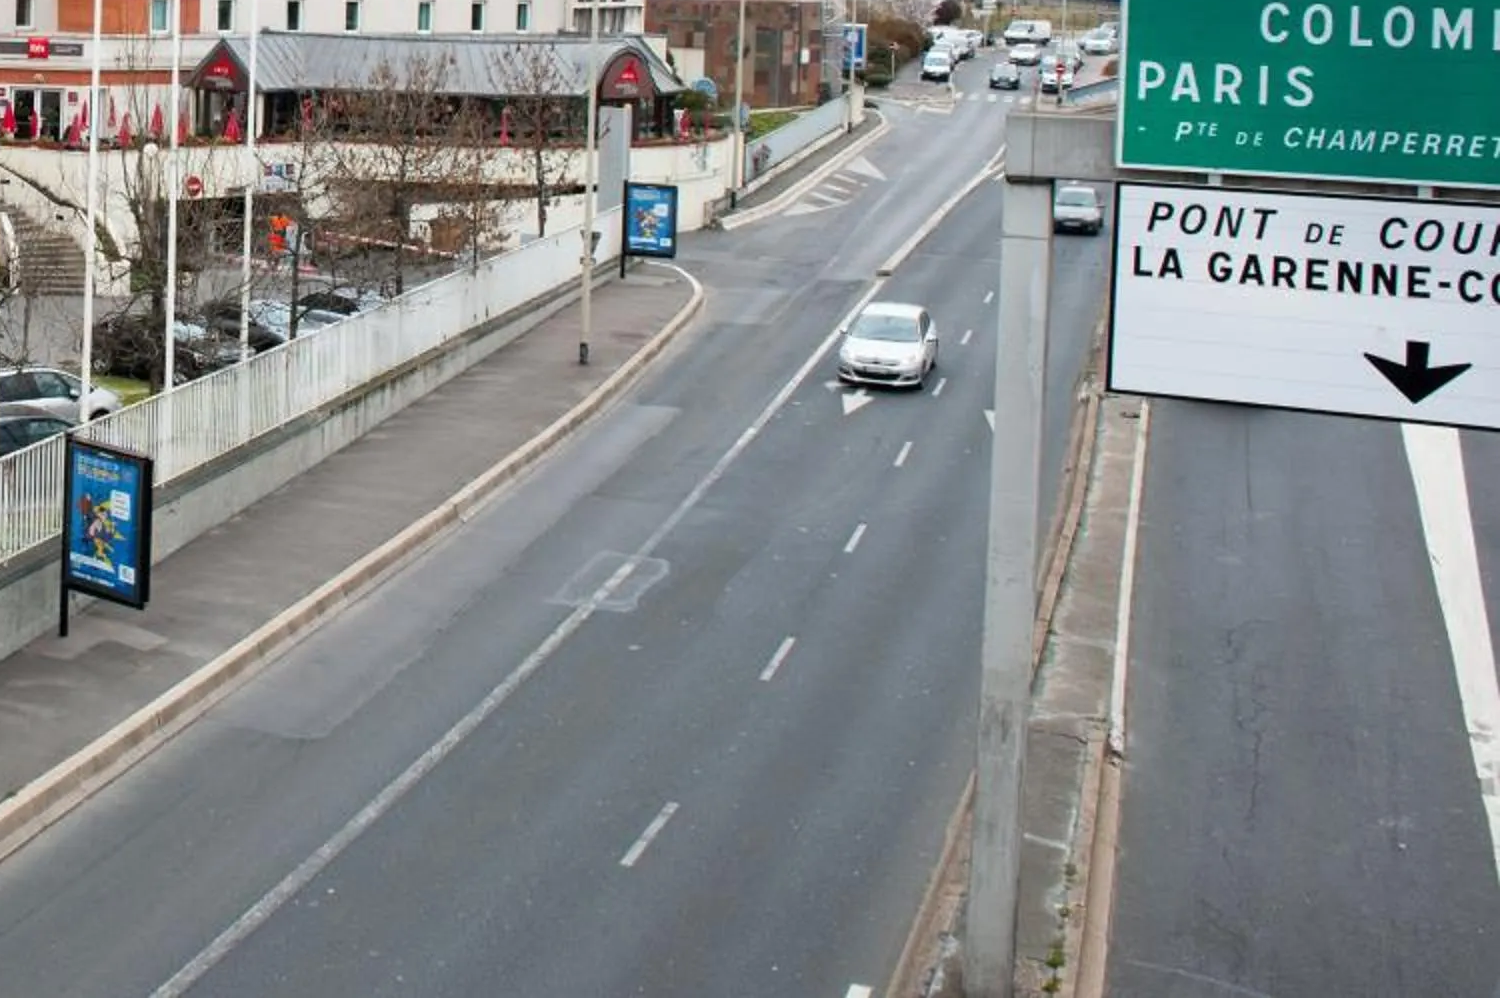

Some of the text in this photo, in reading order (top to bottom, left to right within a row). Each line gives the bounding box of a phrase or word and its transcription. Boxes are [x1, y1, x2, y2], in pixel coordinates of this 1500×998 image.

[1260, 2, 1500, 51] COLOM
[1137, 61, 1314, 107] PARIS
[1235, 131, 1263, 146] DE
[1147, 202, 1278, 240] PONT
[1304, 223, 1345, 246] DE
[1133, 246, 1183, 279] LA
